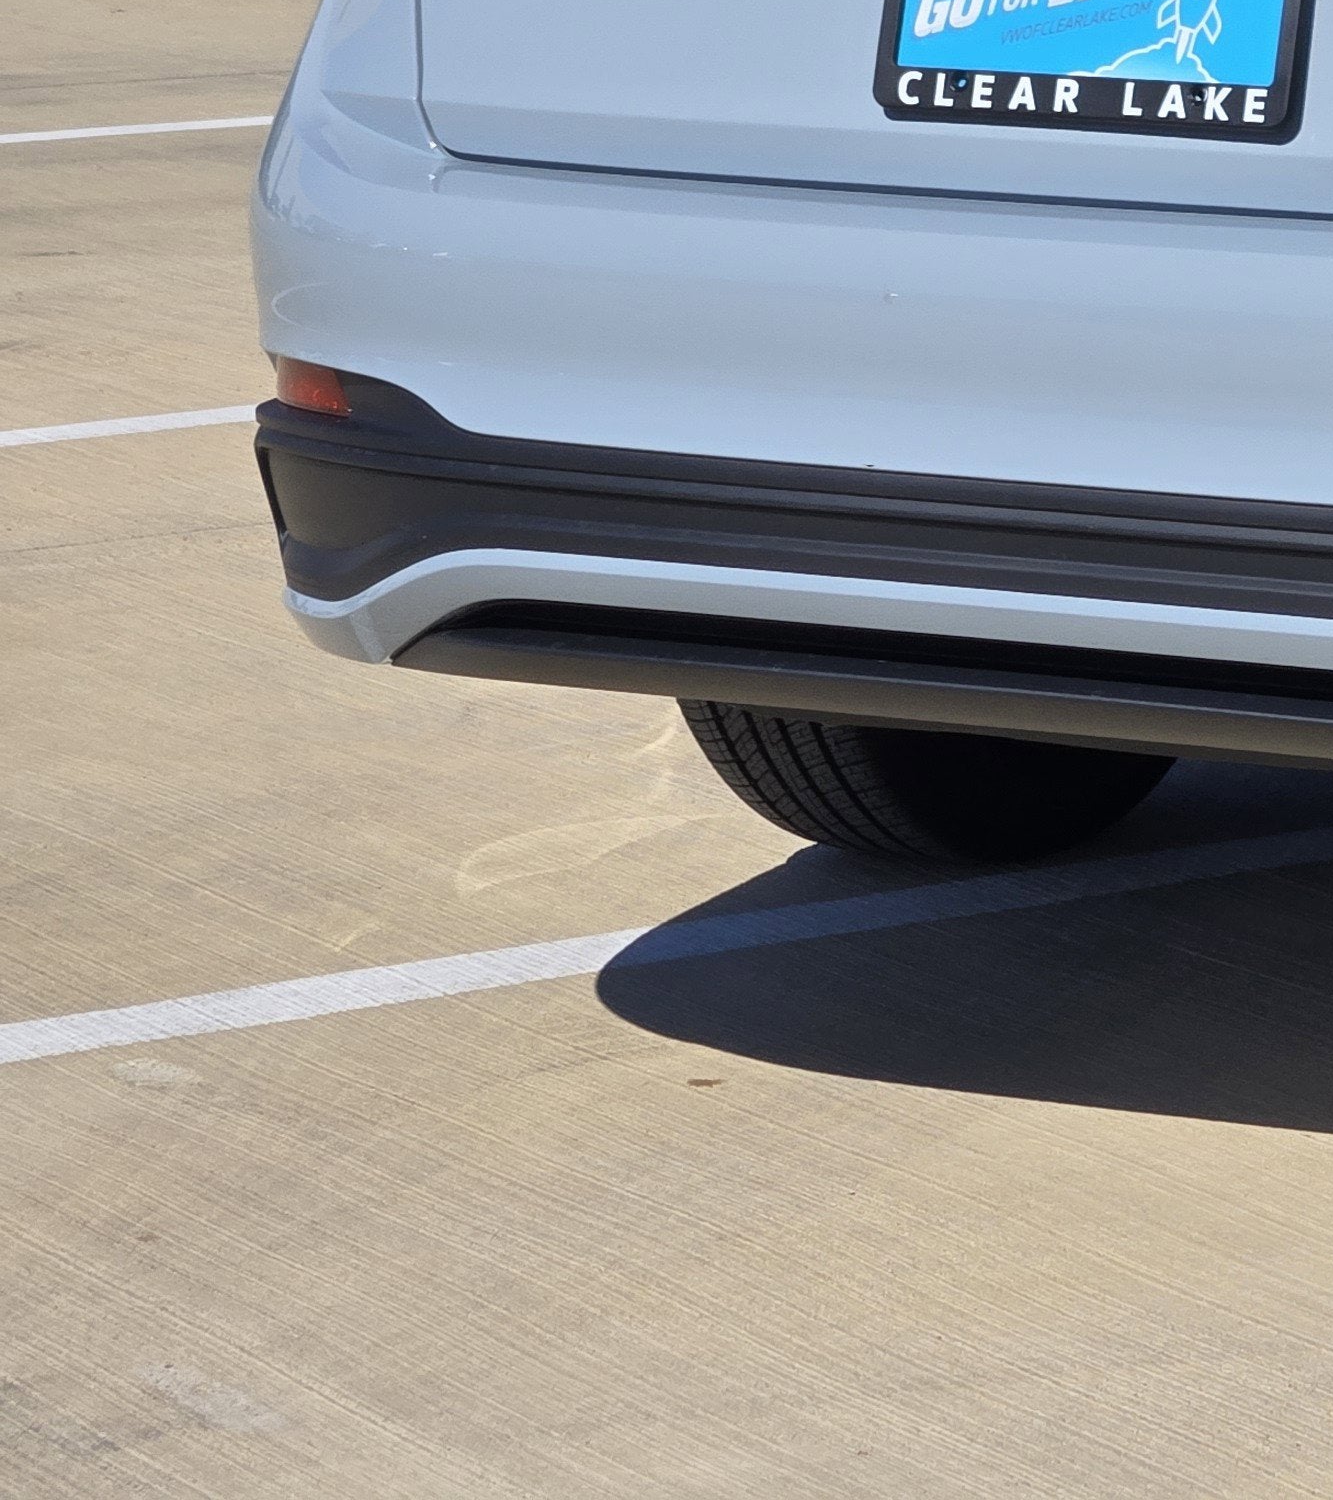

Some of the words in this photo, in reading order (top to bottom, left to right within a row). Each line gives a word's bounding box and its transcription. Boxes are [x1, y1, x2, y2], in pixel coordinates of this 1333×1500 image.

[1000, 0, 1154, 45] VWOFCLEARLAKE.COM
[898, 70, 1079, 113] CLEAR
[1121, 81, 1268, 123] LAKE
